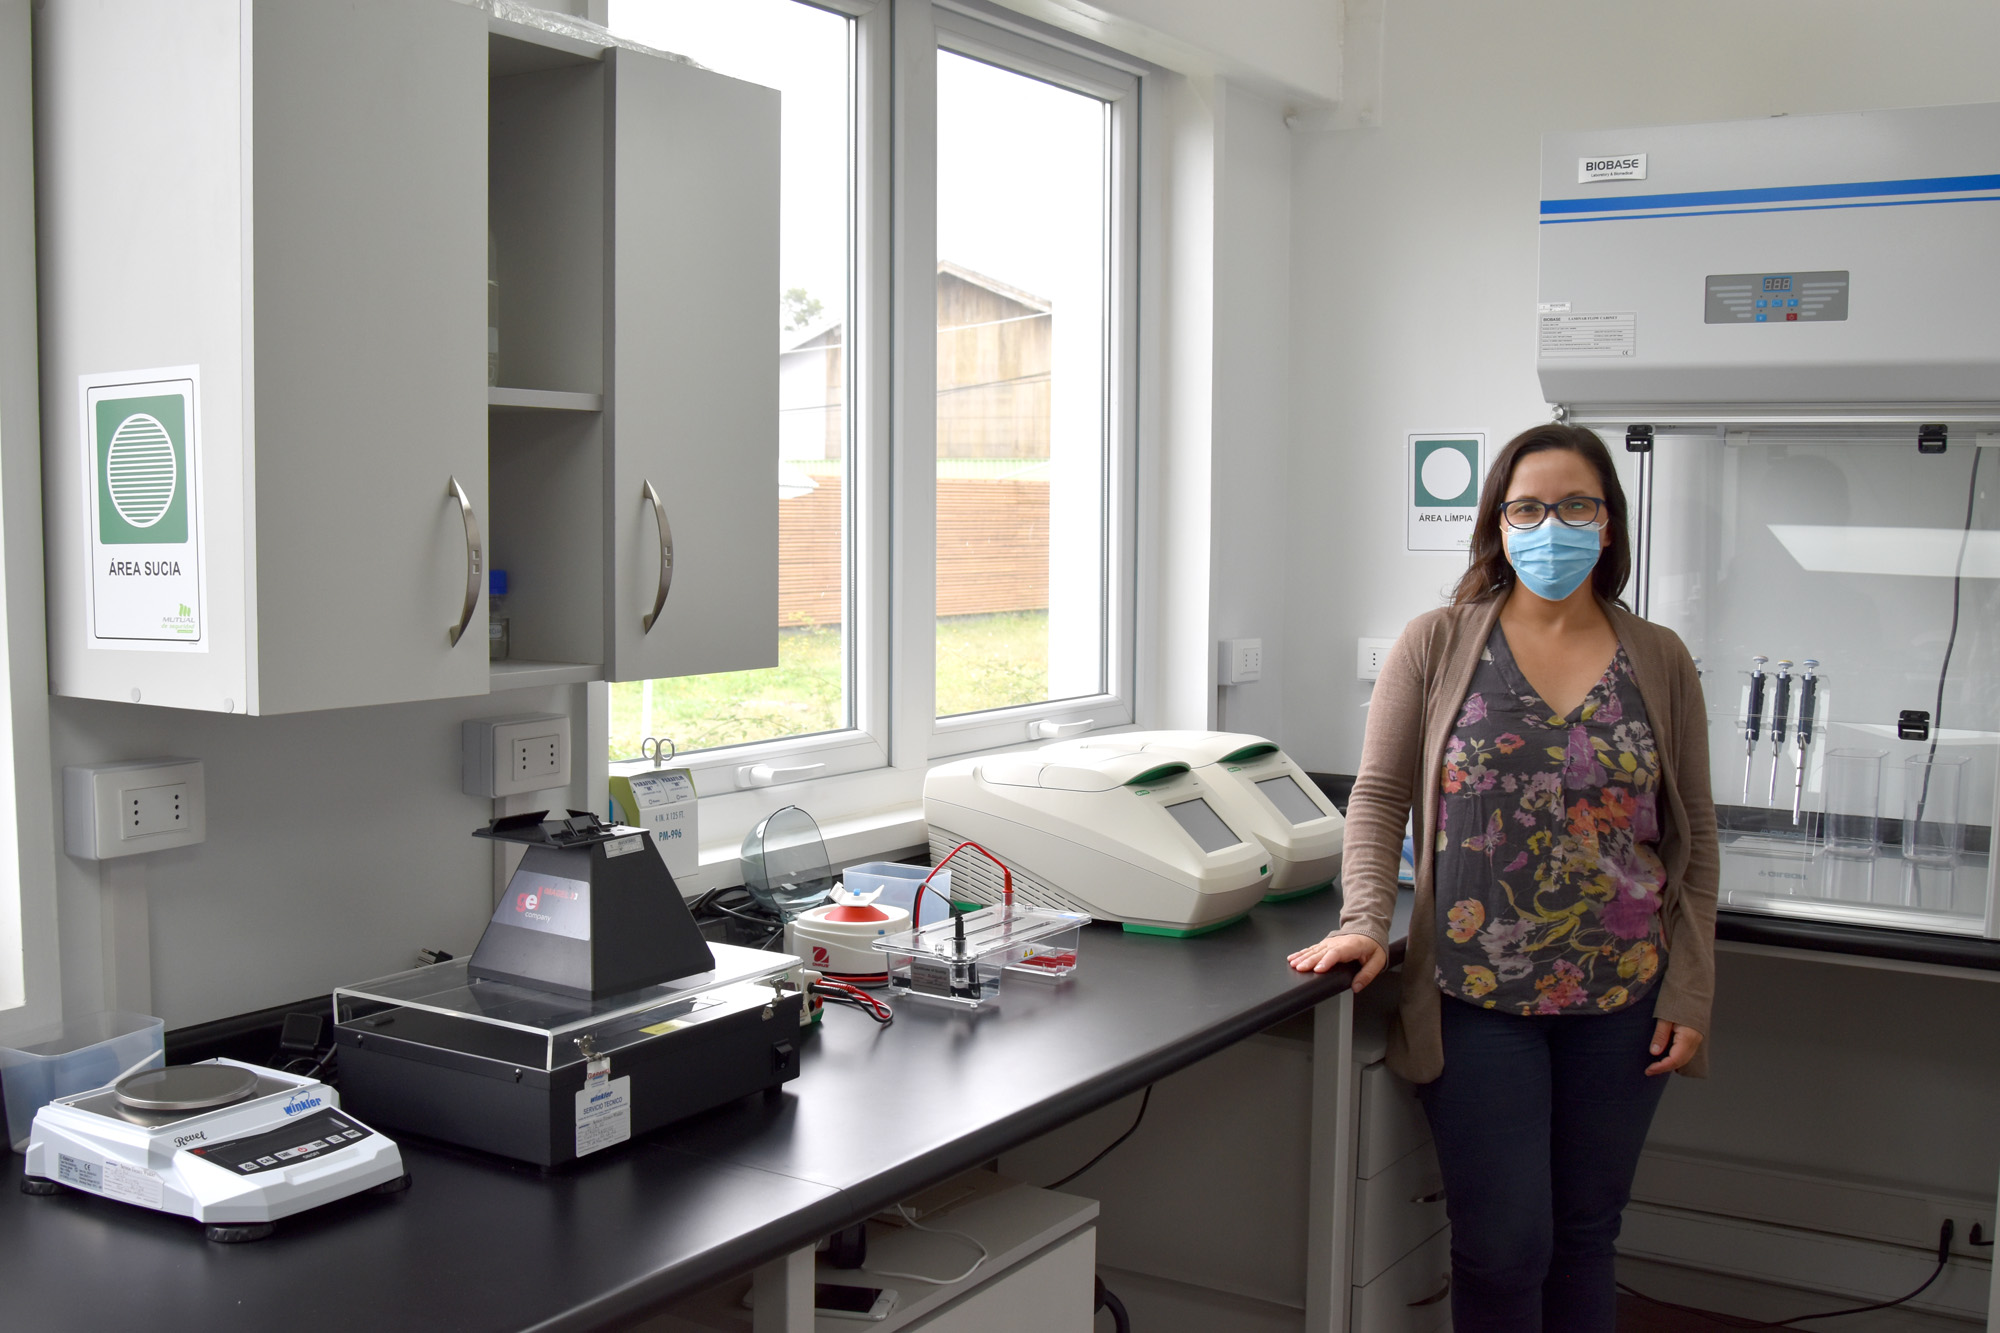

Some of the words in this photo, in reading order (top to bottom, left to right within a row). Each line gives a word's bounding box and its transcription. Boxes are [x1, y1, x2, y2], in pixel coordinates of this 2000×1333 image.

[1585, 159, 1639, 171] BIOBASE
[1419, 513, 1442, 522] ÁREA
[1444, 513, 1473, 522] LÍMPIA
[109, 558, 141, 576] ÁREA
[144, 561, 181, 576] SUCIA
[659, 829, 682, 841] PM-996
[515, 886, 543, 912] gel
[525, 912, 552, 924] company
[283, 1095, 322, 1116] winkler
[583, 1102, 604, 1115] SERVICIO
